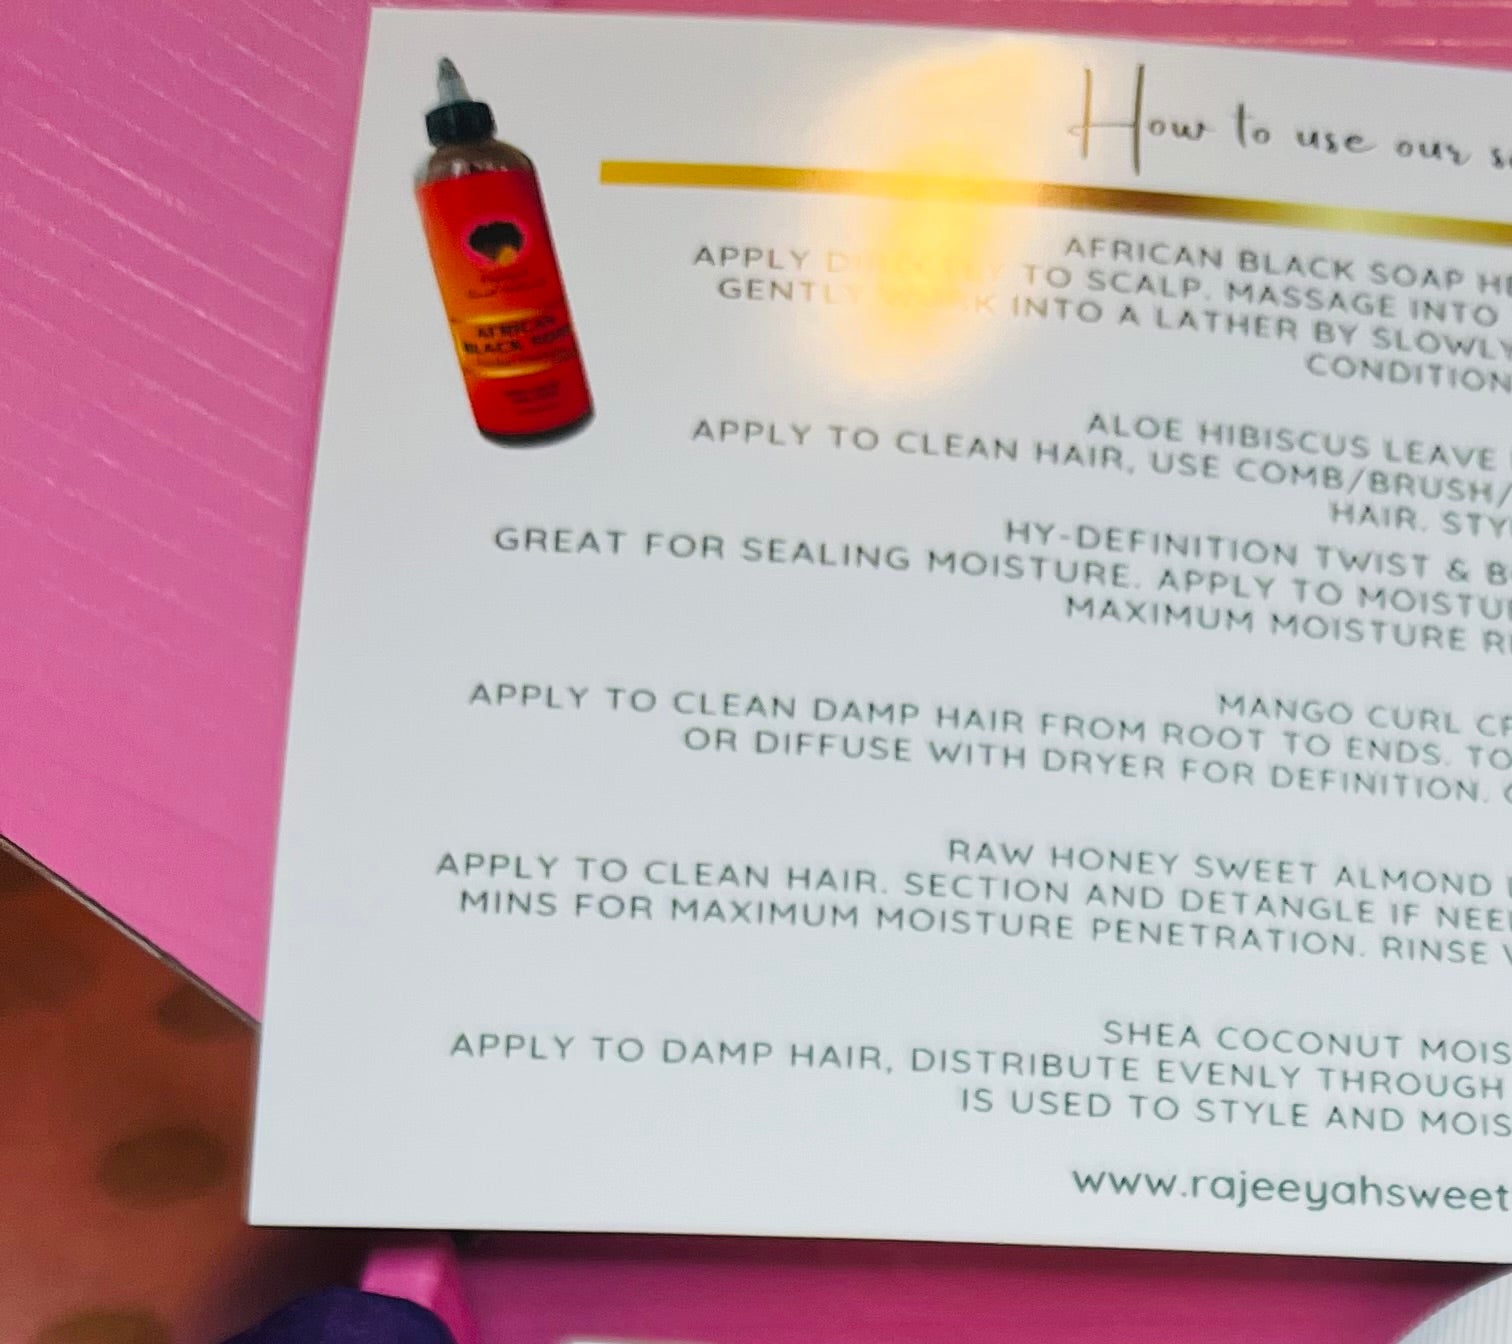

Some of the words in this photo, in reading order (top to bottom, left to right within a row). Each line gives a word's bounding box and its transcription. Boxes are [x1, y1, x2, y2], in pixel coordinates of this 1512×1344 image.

[1067, 63, 1209, 177] How
[1233, 101, 1273, 148] to
[1295, 127, 1378, 154] use
[1393, 137, 1473, 166] our
[1065, 236, 1223, 269] AFRICAN
[1237, 247, 1354, 280] BLACK
[1368, 260, 1464, 290] SOAP
[1087, 411, 1182, 442] ALOE
[1198, 421, 1370, 458] HIBISCUS
[1383, 439, 1495, 471] LEAVE
[1329, 502, 1430, 532] HAIR.
[1004, 519, 1298, 566] HY-DEFINITION
[1314, 544, 1430, 578] TWIST
[1445, 557, 1469, 582] &
[1065, 594, 1254, 634] MAXIMUM
[1270, 612, 1466, 651] MOISTURE
[1218, 693, 1353, 725] MANGO
[1366, 704, 1460, 734] CURL
[948, 837, 1034, 866] RAW
[1050, 845, 1178, 875] HONEY
[1195, 854, 1317, 884] SWEET
[1335, 865, 1492, 897] ALMOND
[449, 1032, 575, 1060] APPLY
[591, 1036, 645, 1062] TO
[662, 1038, 773, 1066] DAMP
[790, 1043, 892, 1075] HAIR,
[910, 1047, 1139, 1081] DISTRIBUTE
[1157, 1058, 1300, 1089] EVENLY
[1316, 1067, 1504, 1099] THROUGH
[1104, 1019, 1201, 1048] SHEA
[1216, 1026, 1402, 1059] COCONUT
[962, 1087, 993, 1113] IS
[1011, 1090, 1111, 1118] USED
[1128, 1094, 1180, 1120] TO
[1195, 1097, 1309, 1128] STYLE
[1325, 1105, 1404, 1132] AND
